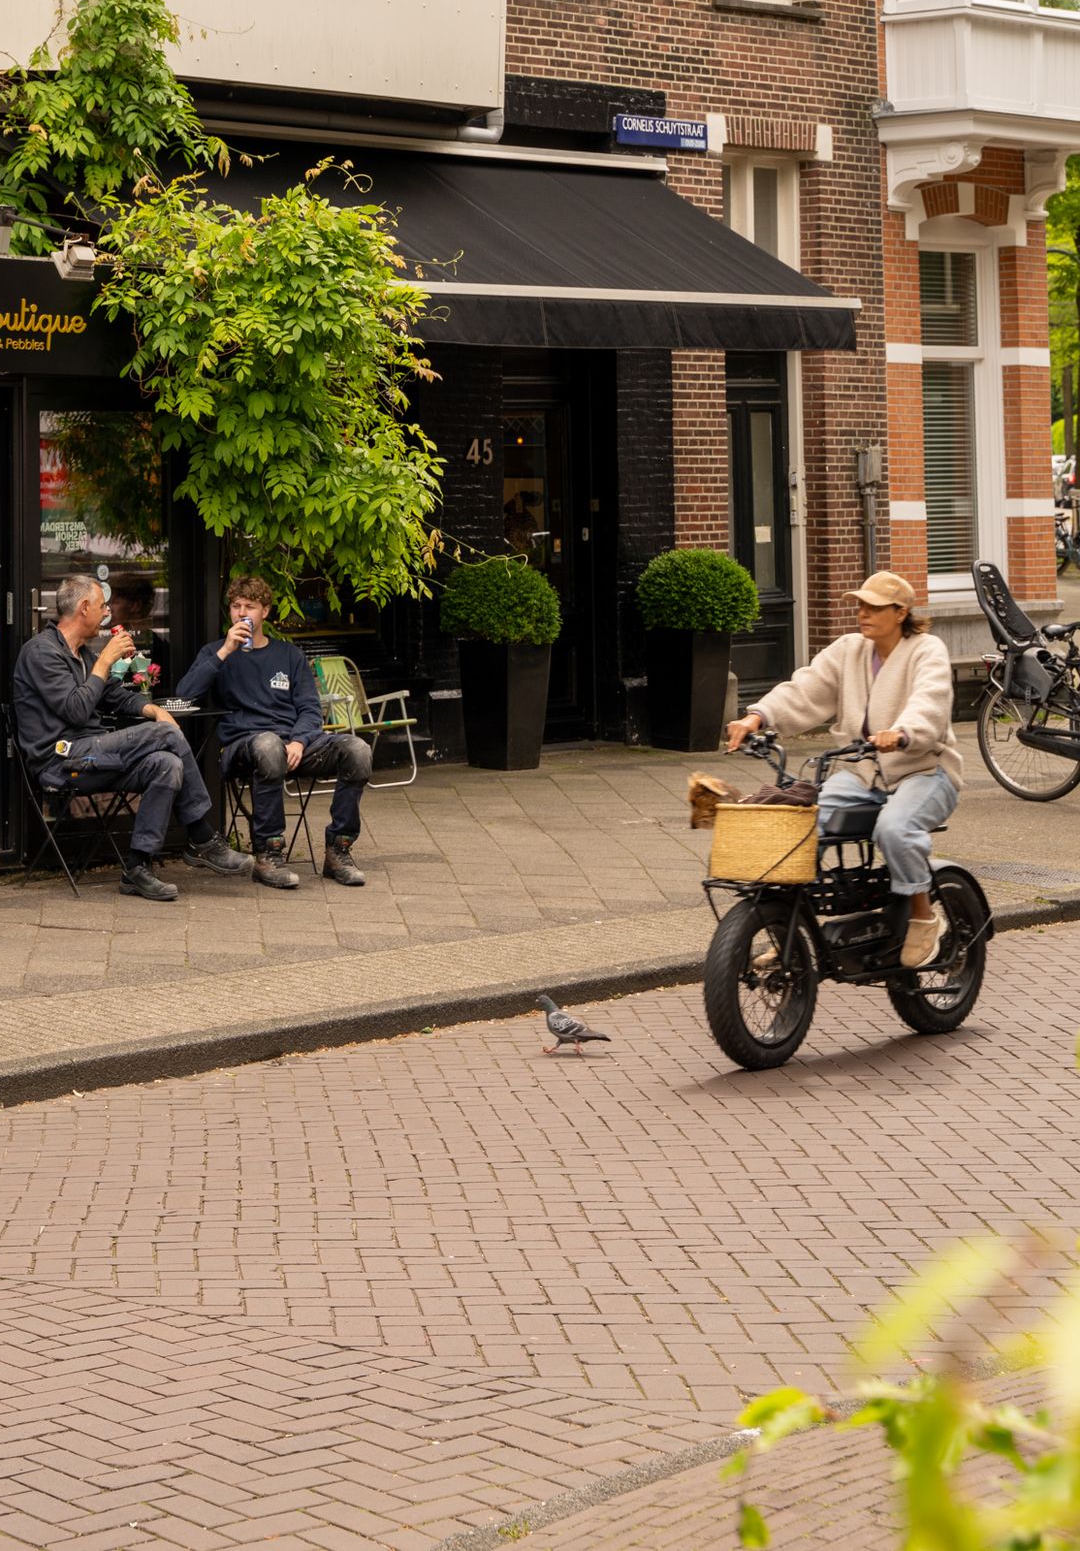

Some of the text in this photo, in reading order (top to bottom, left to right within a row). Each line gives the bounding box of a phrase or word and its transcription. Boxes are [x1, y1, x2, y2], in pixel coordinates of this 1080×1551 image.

[622, 117, 705, 138] CORNELIS SCHUYTSTRAAT
[6, 337, 46, 351] Pebbles
[466, 438, 493, 465] 45
